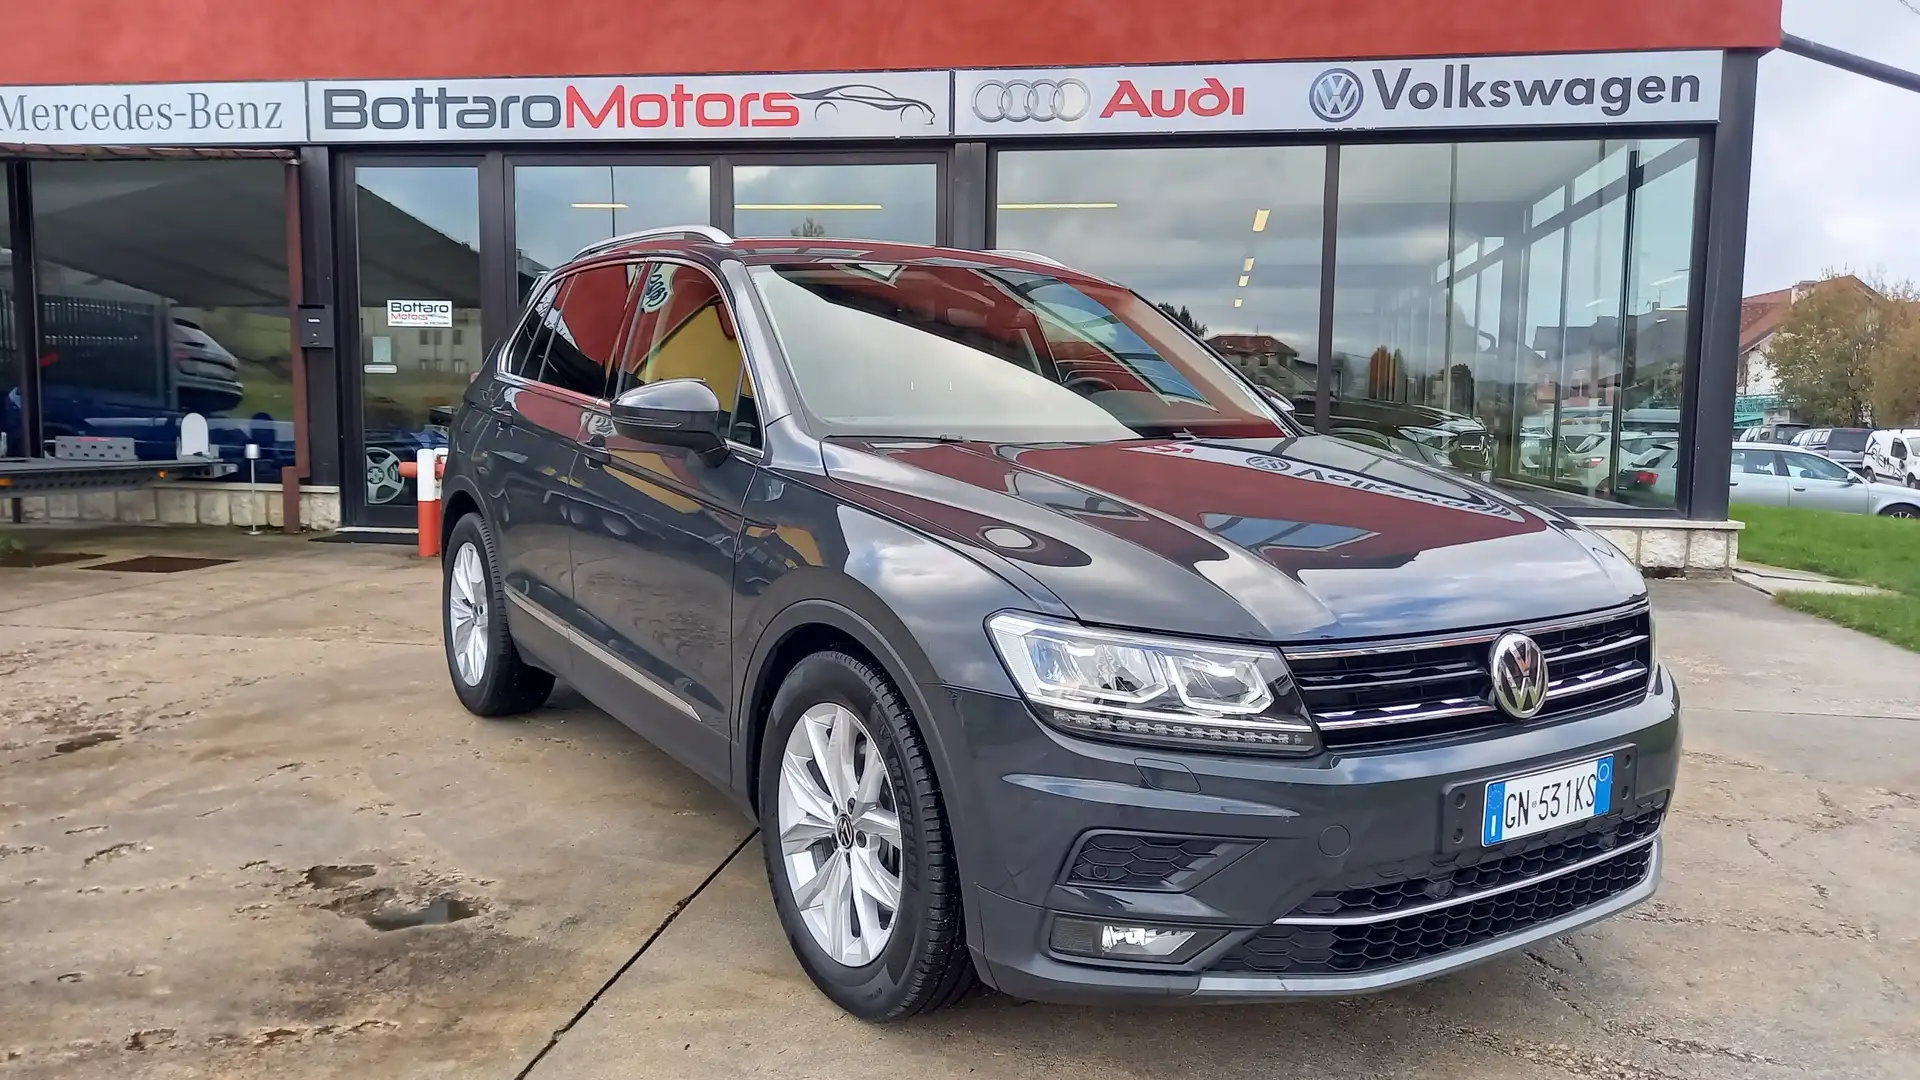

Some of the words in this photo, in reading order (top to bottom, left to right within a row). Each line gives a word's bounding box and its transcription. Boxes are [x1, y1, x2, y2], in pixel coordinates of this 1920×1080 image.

[1099, 78, 1245, 119] Audi
[1372, 64, 1701, 117] Volkswagen
[0, 92, 283, 132] Mercedes-Benz
[390, 302, 449, 313] Bottaro
[391, 313, 428, 321] Motors
